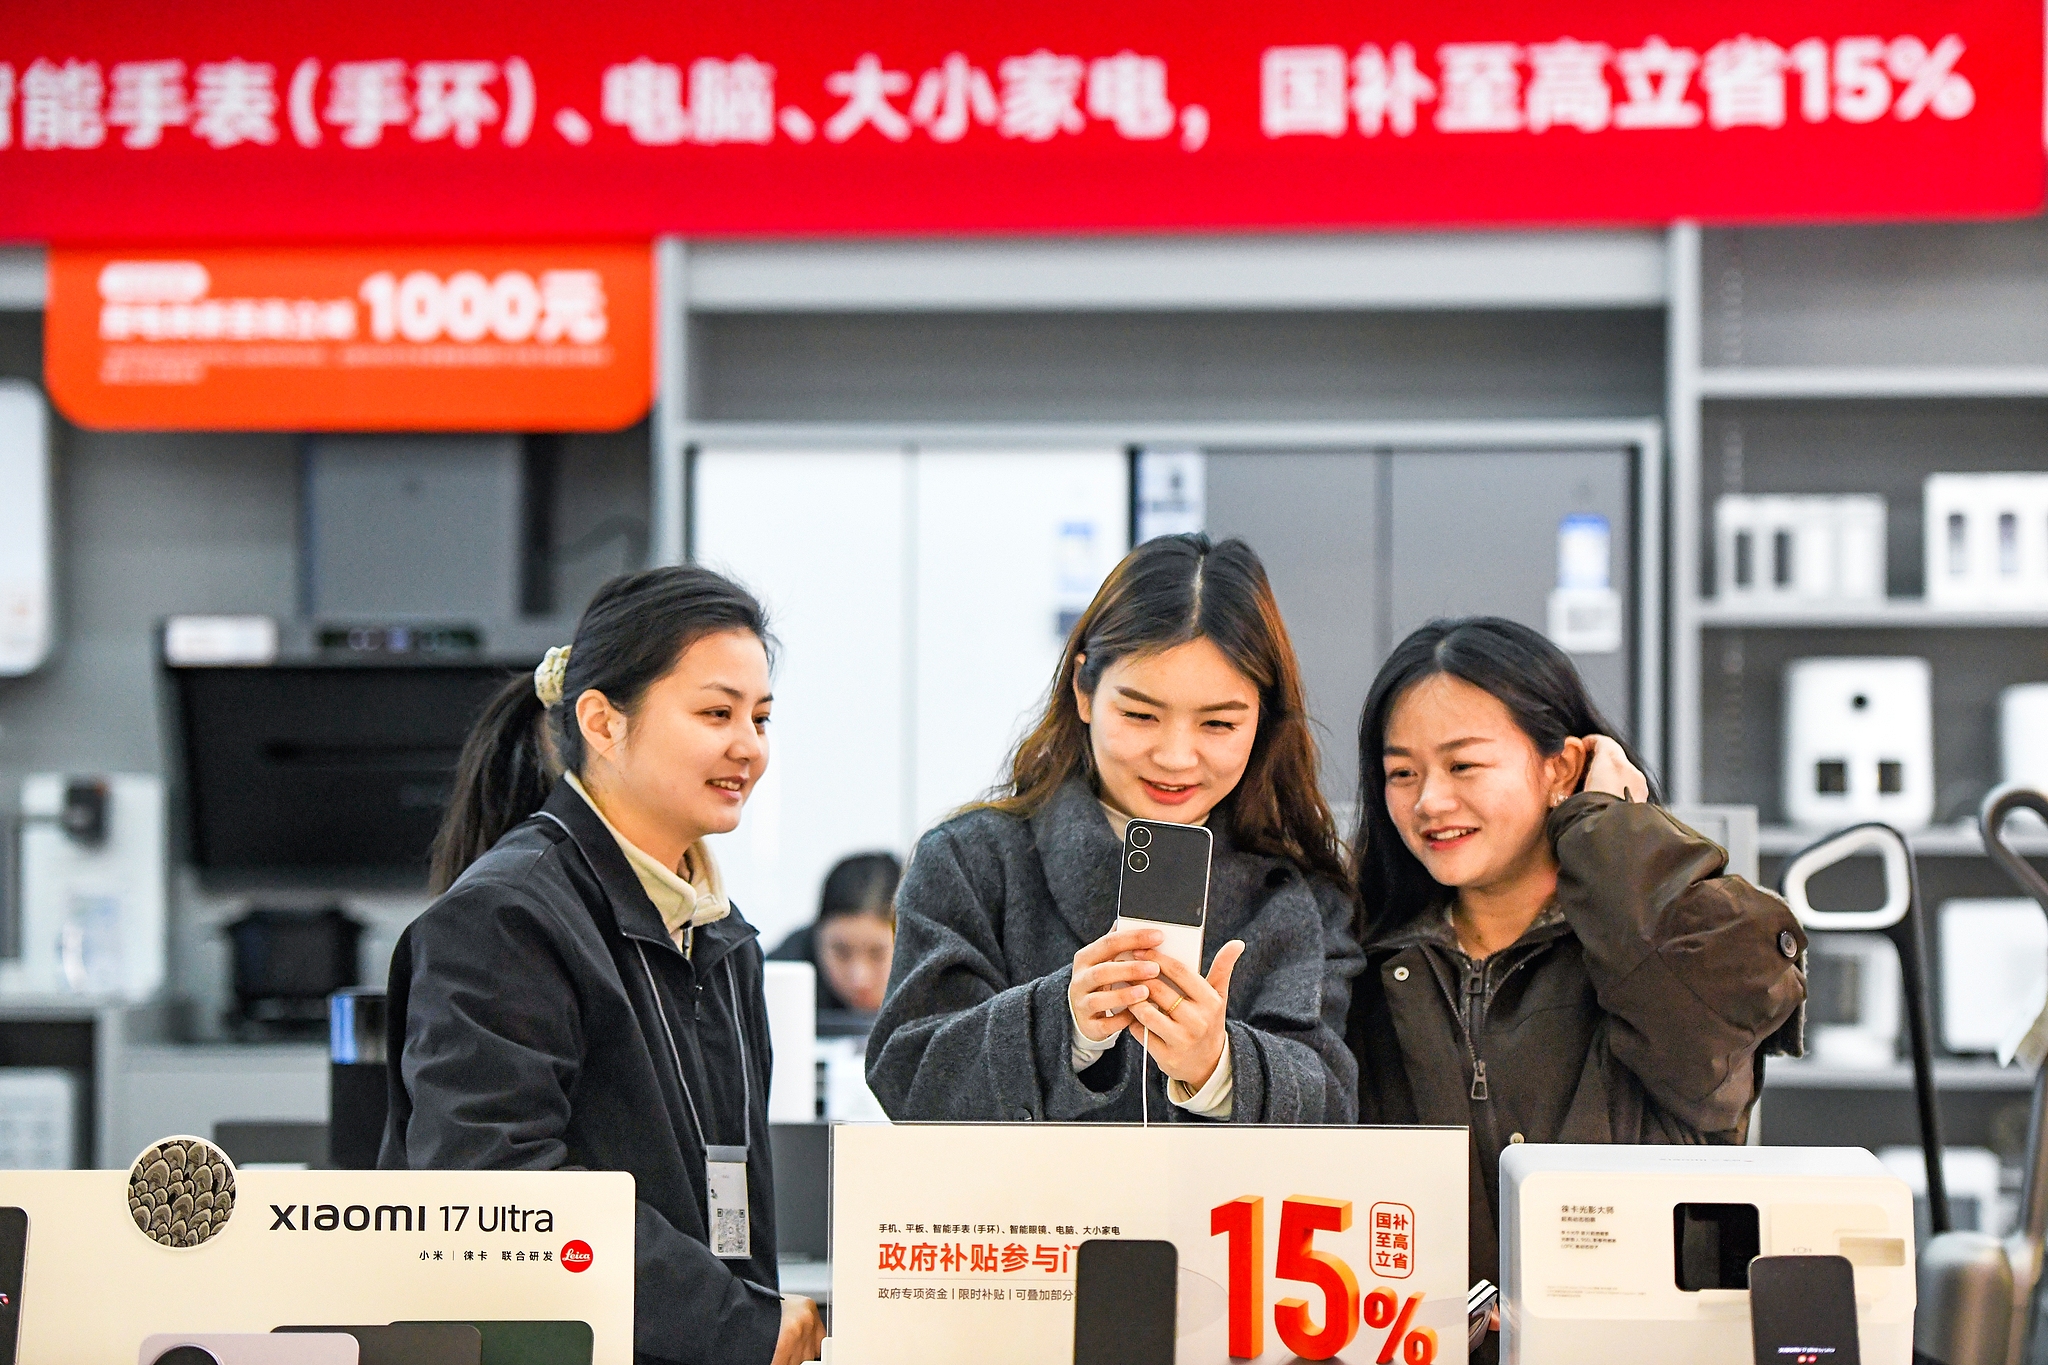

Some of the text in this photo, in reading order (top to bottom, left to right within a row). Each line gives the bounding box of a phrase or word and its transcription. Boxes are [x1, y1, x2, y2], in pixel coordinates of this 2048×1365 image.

[361, 271, 606, 343] 1000元
[439, 1205, 470, 1232] 17
[478, 1204, 554, 1232] Ultra
[1376, 1212, 1409, 1231] 国补
[1376, 1231, 1409, 1251] 至高
[419, 1250, 553, 1262] 小米 徕卡 联合研发
[561, 1247, 591, 1263] Leica
[1376, 1250, 1409, 1270] 立省
[878, 1287, 948, 1300] 政府专项资金
[958, 1288, 1005, 1301] 限时补贴
